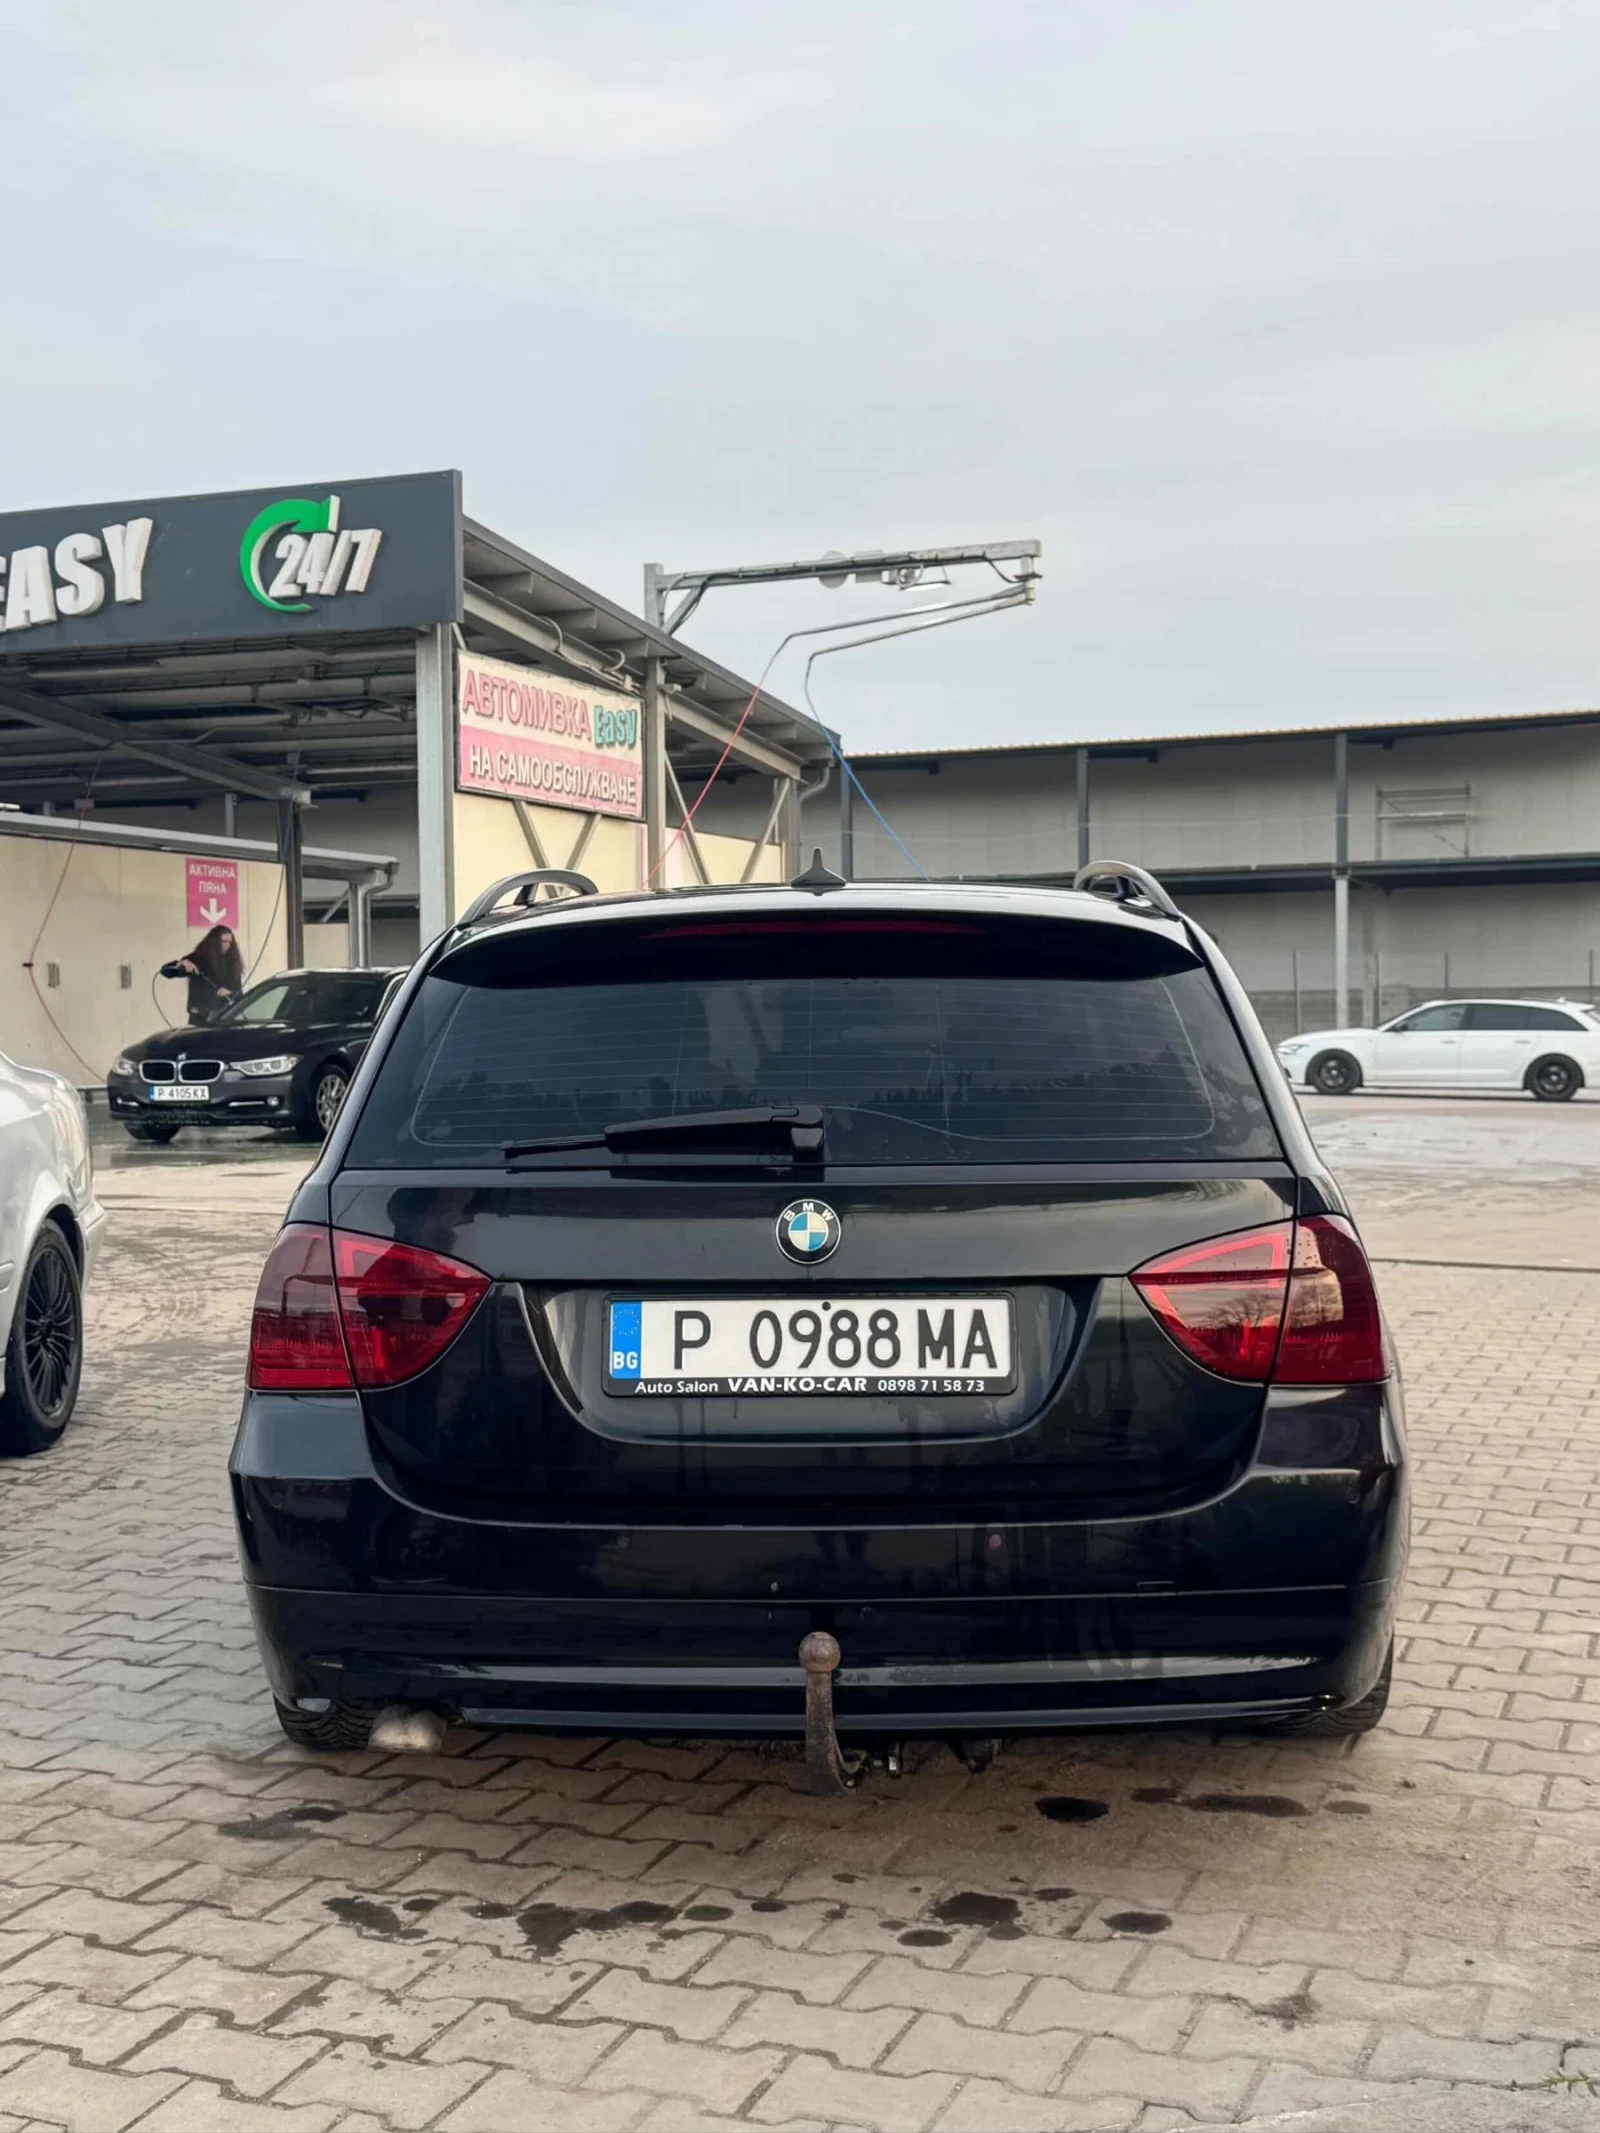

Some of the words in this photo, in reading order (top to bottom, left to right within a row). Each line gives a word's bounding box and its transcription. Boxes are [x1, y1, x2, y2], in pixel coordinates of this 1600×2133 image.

[0, 517, 153, 632] ASY
[268, 528, 382, 599] 24/7
[462, 669, 592, 741] АВТОМИВКА
[593, 705, 637, 748] Easy
[469, 744, 493, 780] НА
[497, 750, 637, 807] САМООБСЛУЖВАНЕ
[188, 863, 236, 879] АКТИВНА
[198, 880, 228, 895] ПЯНА
[783, 1201, 835, 1222] BMW
[612, 1351, 638, 1370] BG
[673, 1310, 711, 1370] P
[748, 1309, 902, 1369] 0988
[917, 1308, 998, 1369] MA
[634, 1381, 673, 1394] Auto
[676, 1380, 719, 1394] Salon
[728, 1377, 868, 1392] VAN-KO-CAR
[877, 1379, 916, 1392] 0898
[920, 1379, 938, 1392] 71
[943, 1379, 962, 1392] 58
[966, 1379, 985, 1392] 73
